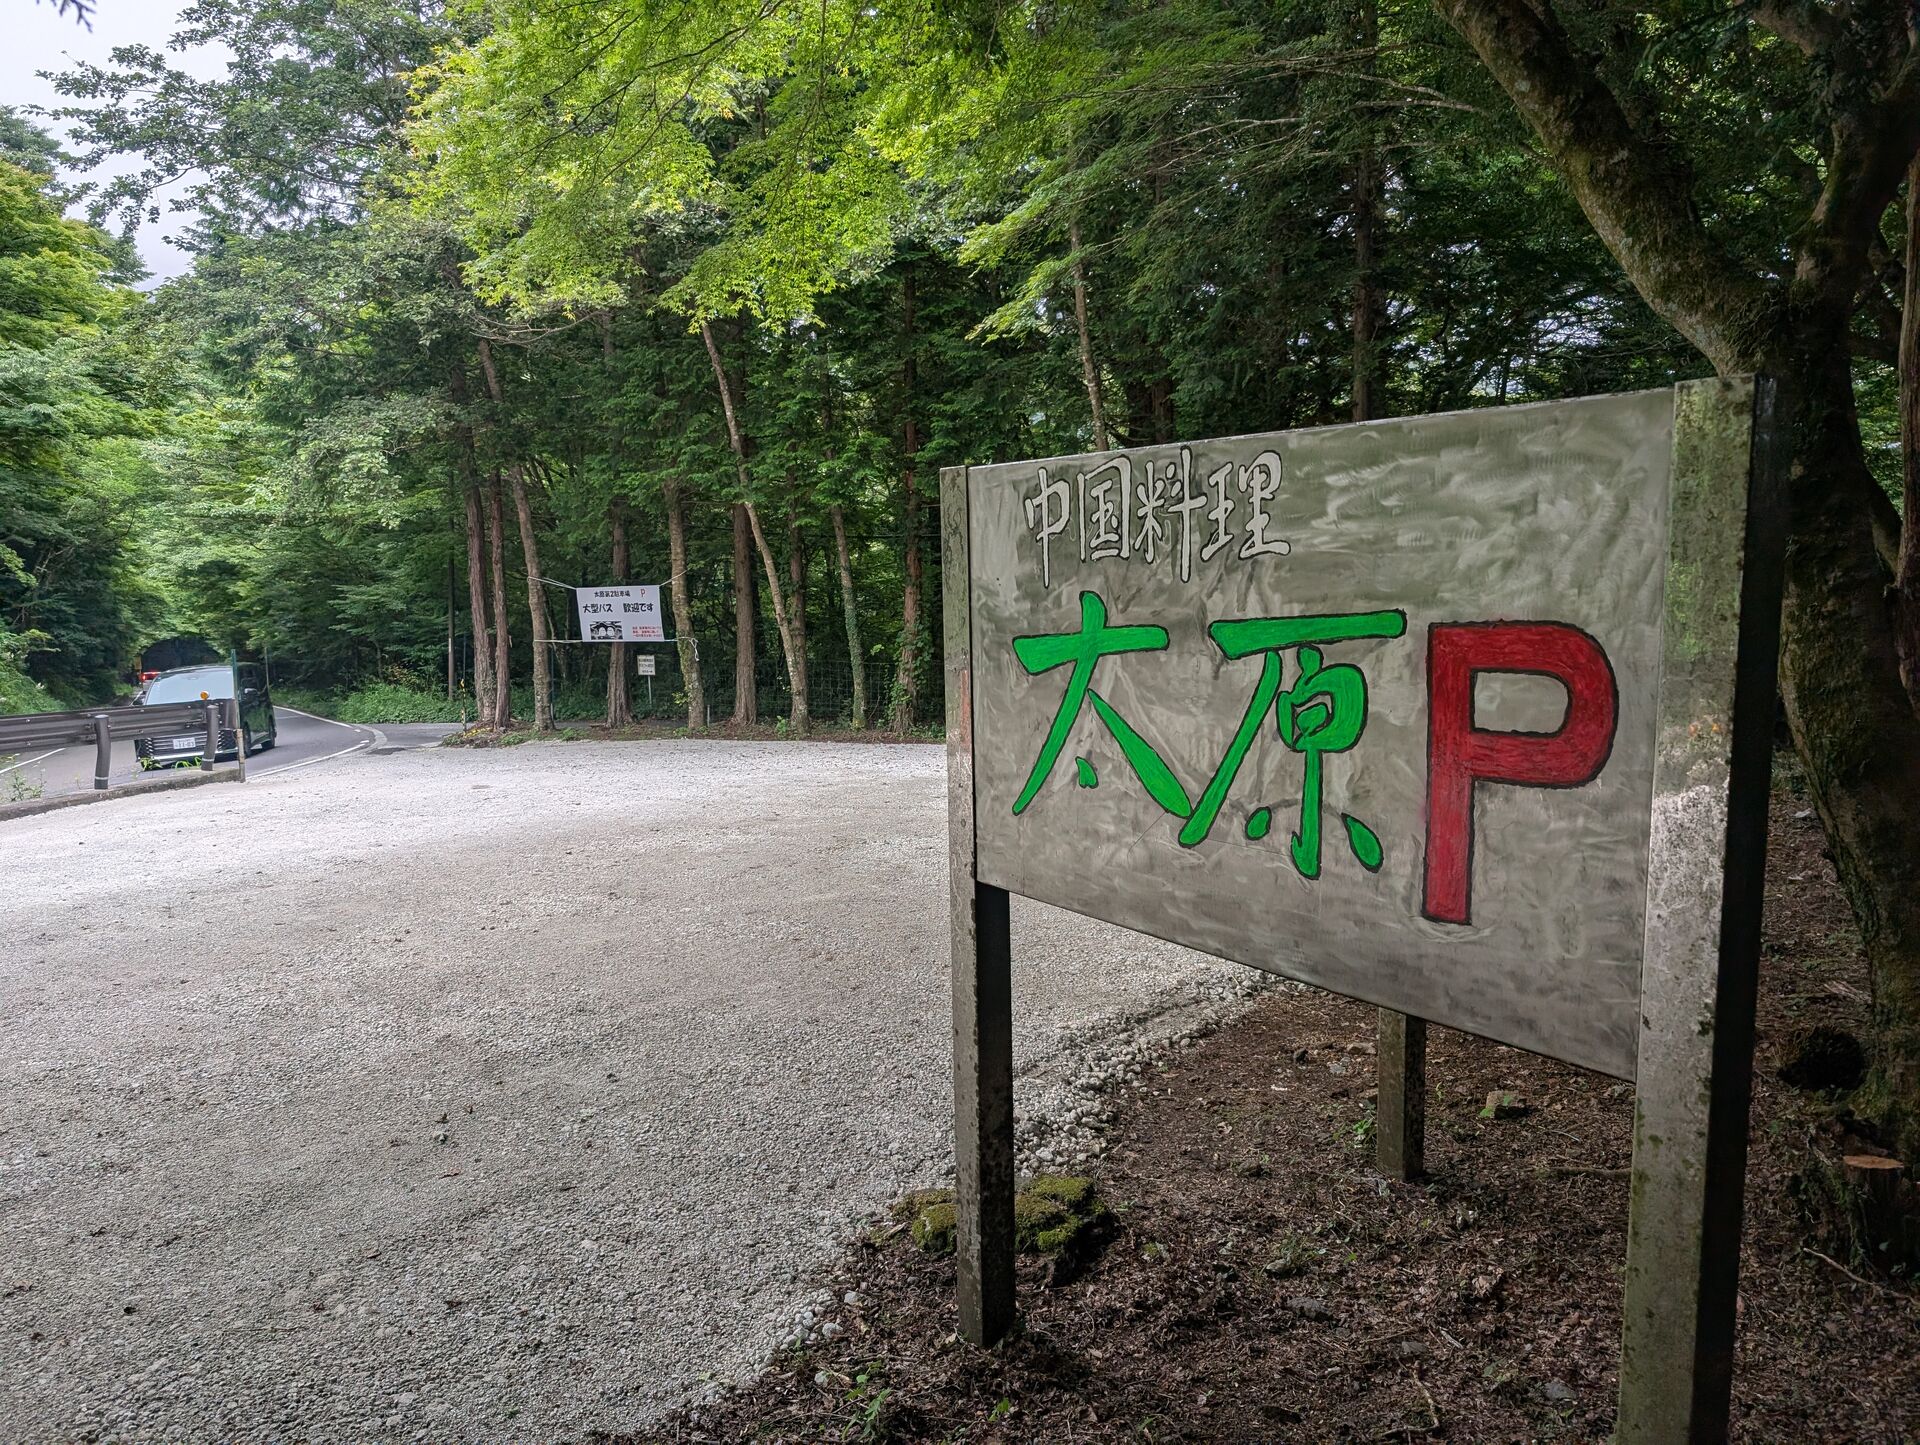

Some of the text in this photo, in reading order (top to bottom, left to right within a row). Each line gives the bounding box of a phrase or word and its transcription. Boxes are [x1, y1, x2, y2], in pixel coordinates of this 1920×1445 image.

[1023, 445, 1290, 588] 中国料理
[640, 588, 646, 598] P
[582, 602, 654, 614] 大型バス 歓迎です
